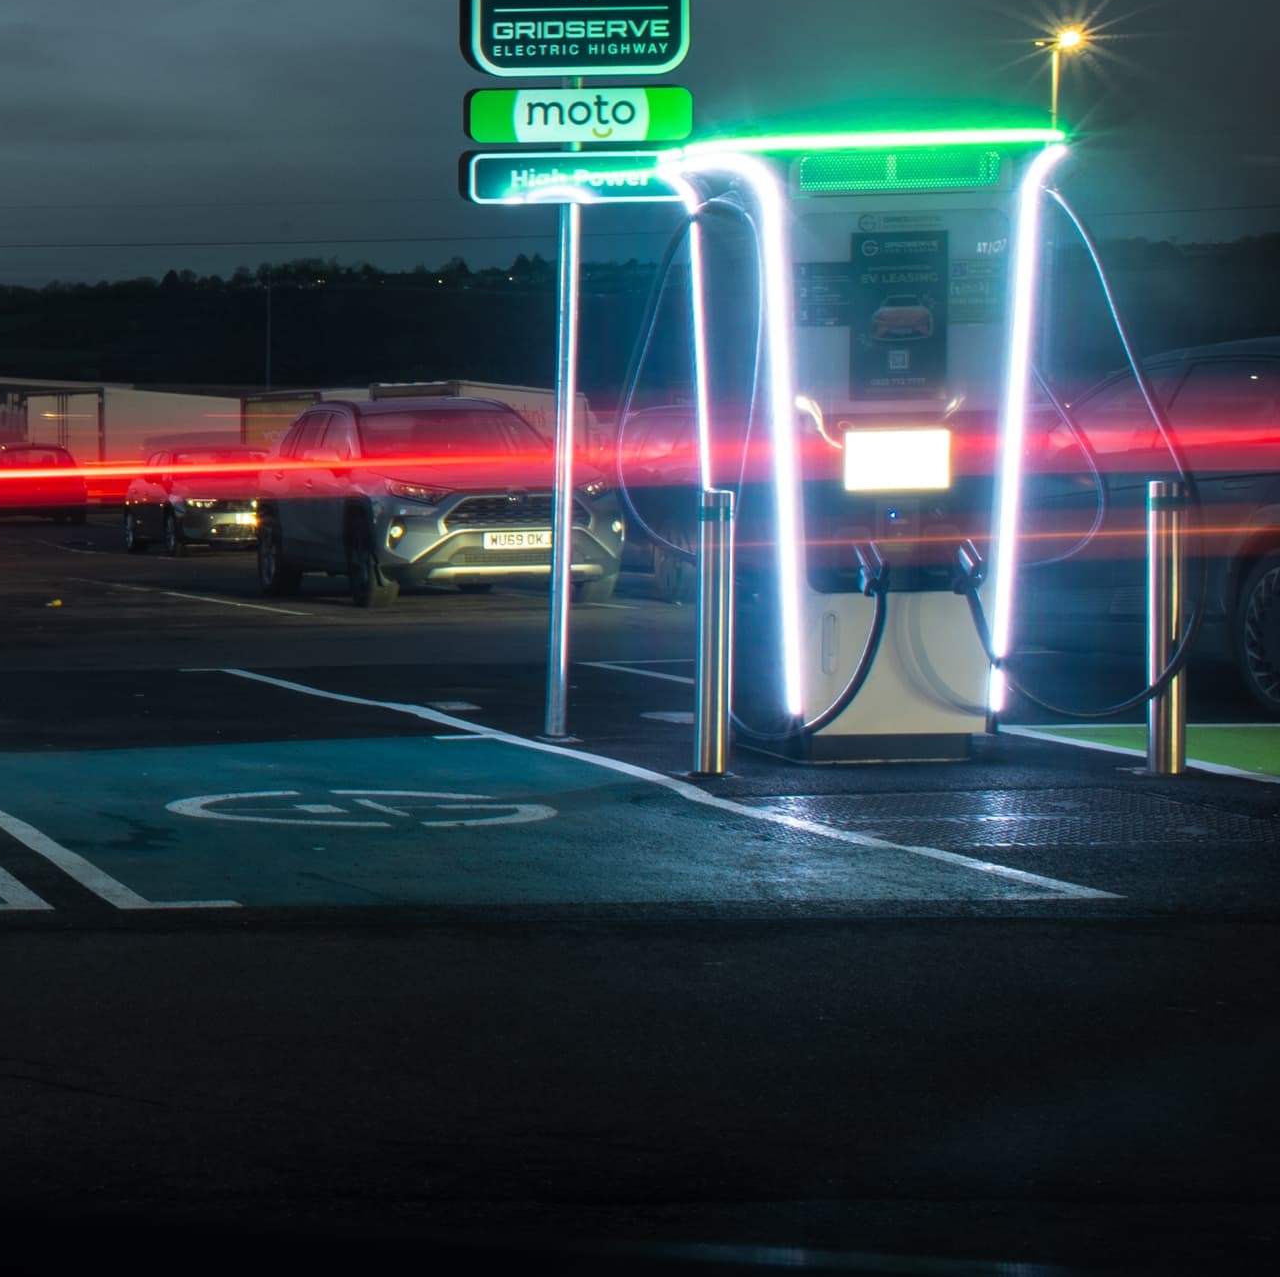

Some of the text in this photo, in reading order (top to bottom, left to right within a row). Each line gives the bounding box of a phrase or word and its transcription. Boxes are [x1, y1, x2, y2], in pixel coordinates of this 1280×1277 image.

[493, 20, 670, 39] GRIDSERVE
[493, 42, 669, 56] ELECTRIC HIGHWAY
[527, 95, 636, 126] moto
[490, 533, 524, 546] WU69
